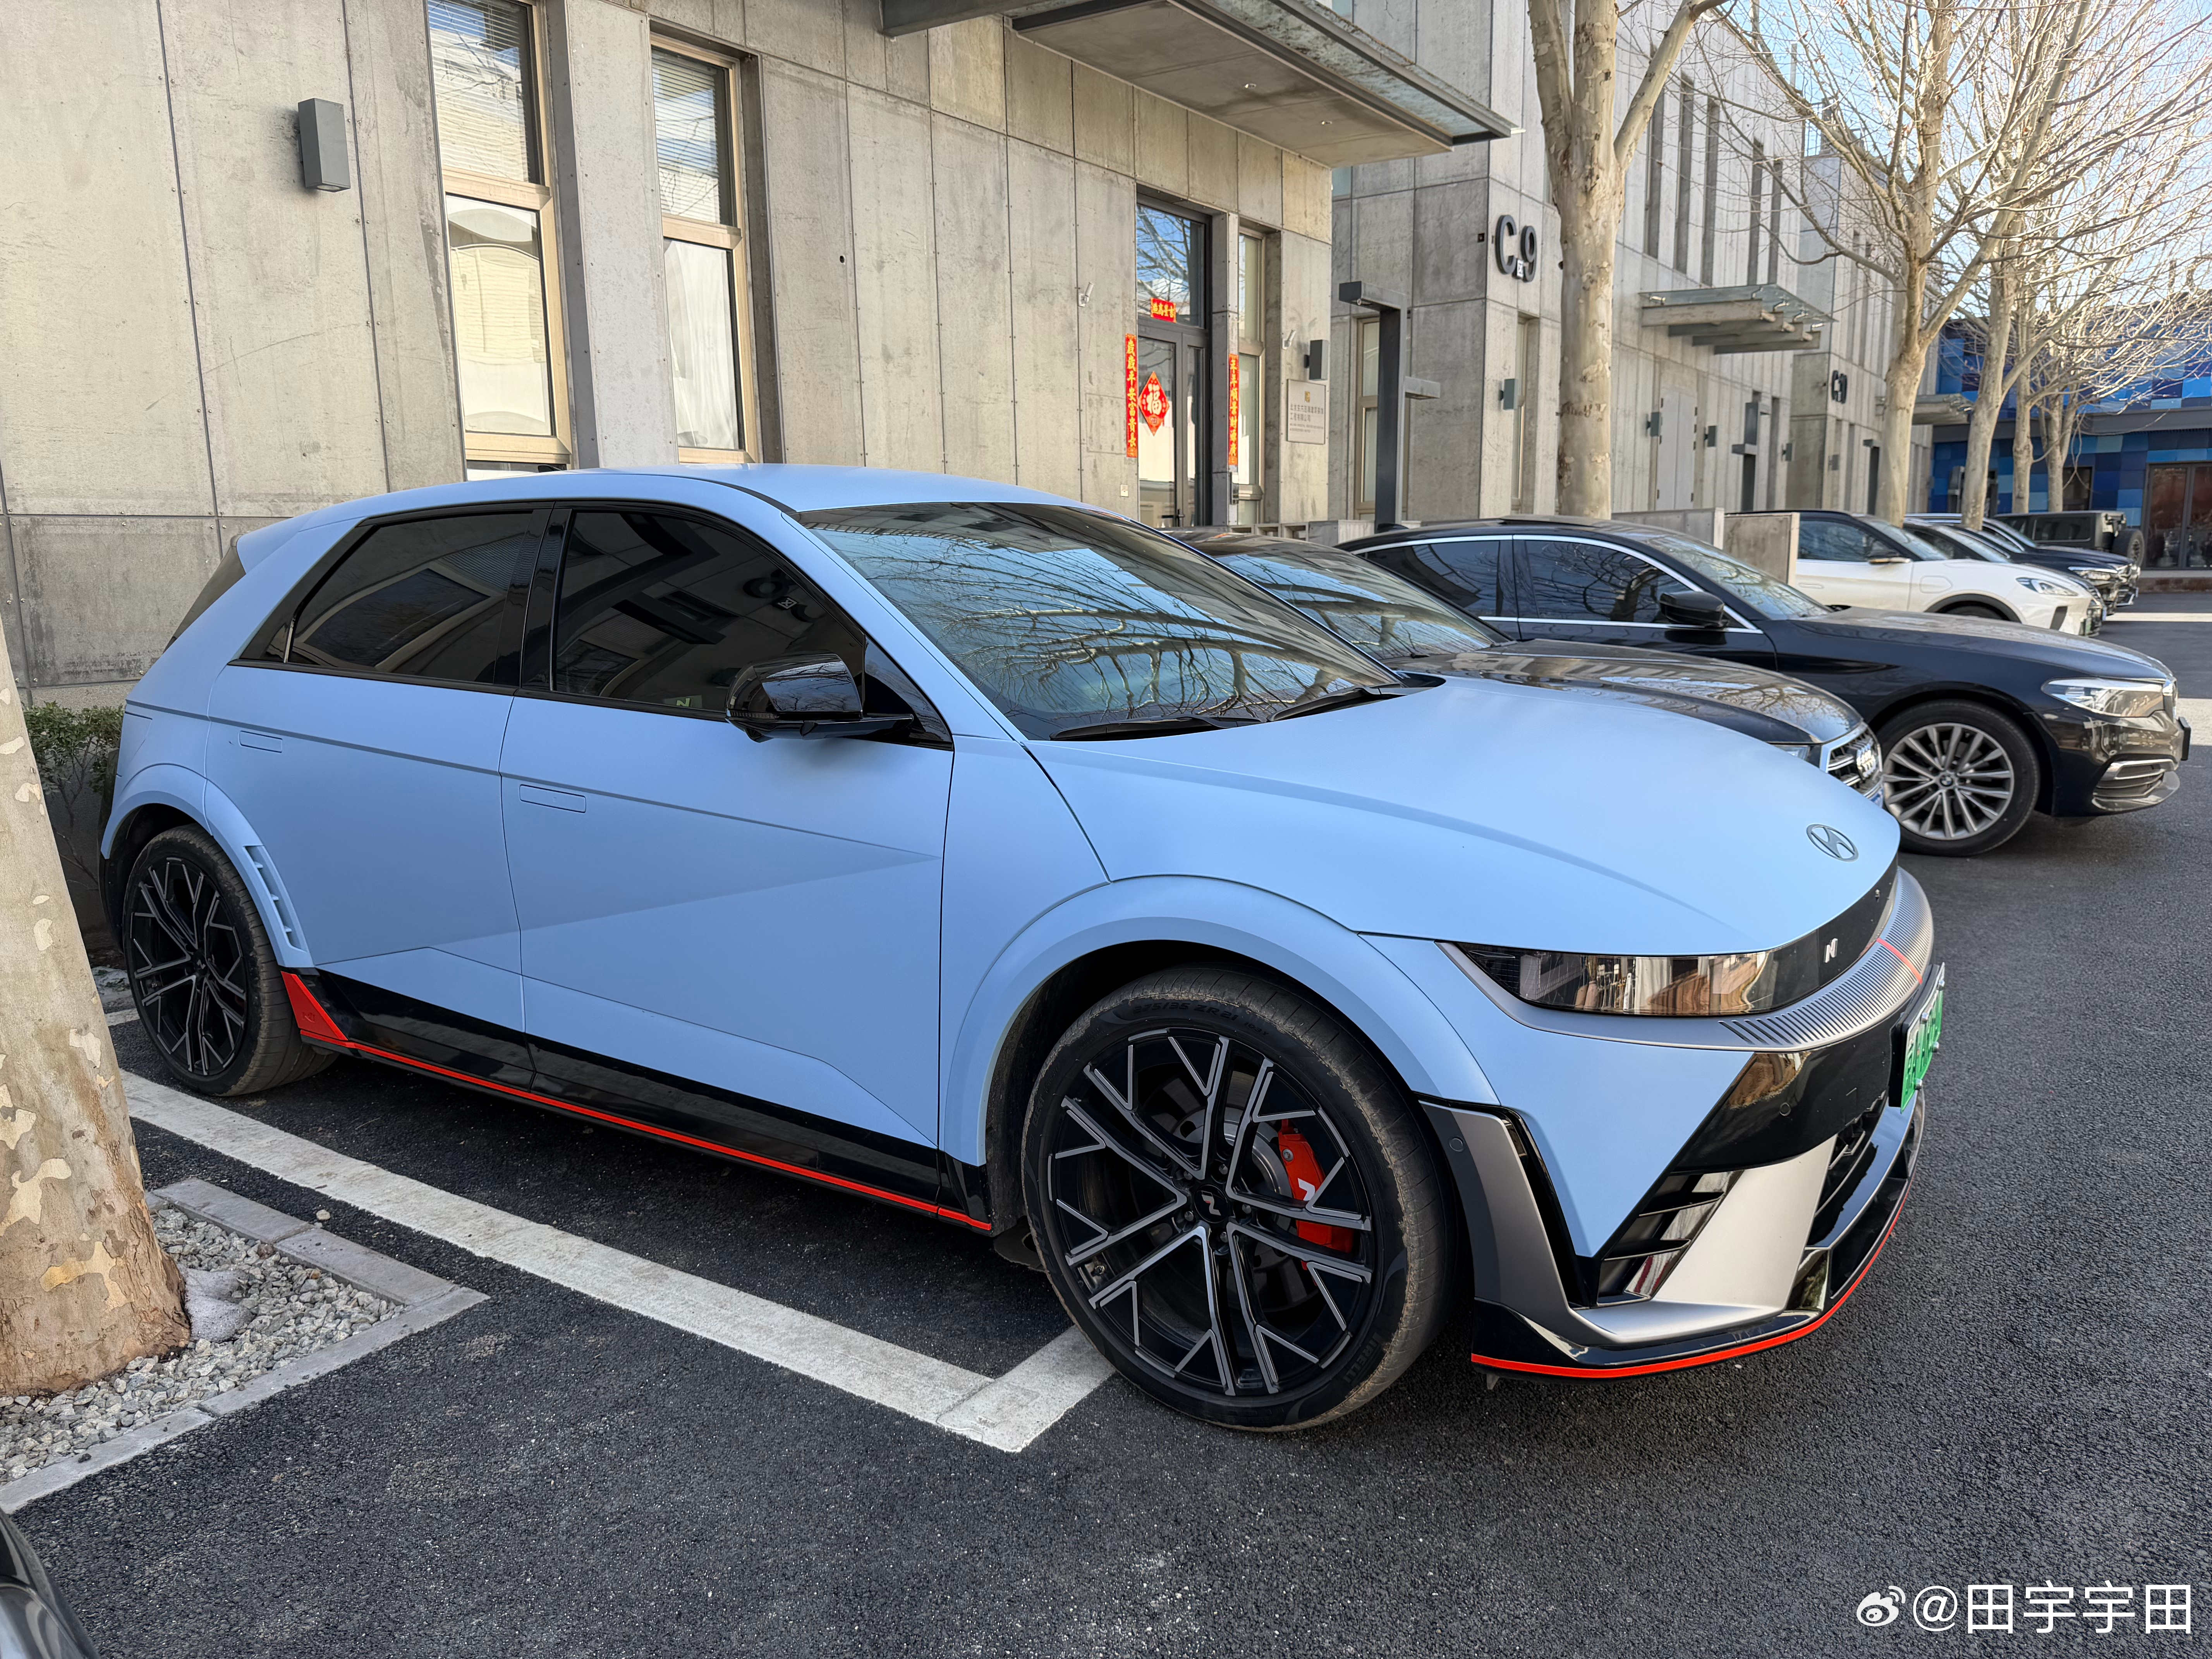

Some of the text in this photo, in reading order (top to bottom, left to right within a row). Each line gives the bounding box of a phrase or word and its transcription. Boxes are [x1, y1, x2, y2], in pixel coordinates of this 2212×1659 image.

[1495, 215, 1537, 283] C9
[1146, 383, 1162, 416] 福
[1824, 938, 1838, 963] N
